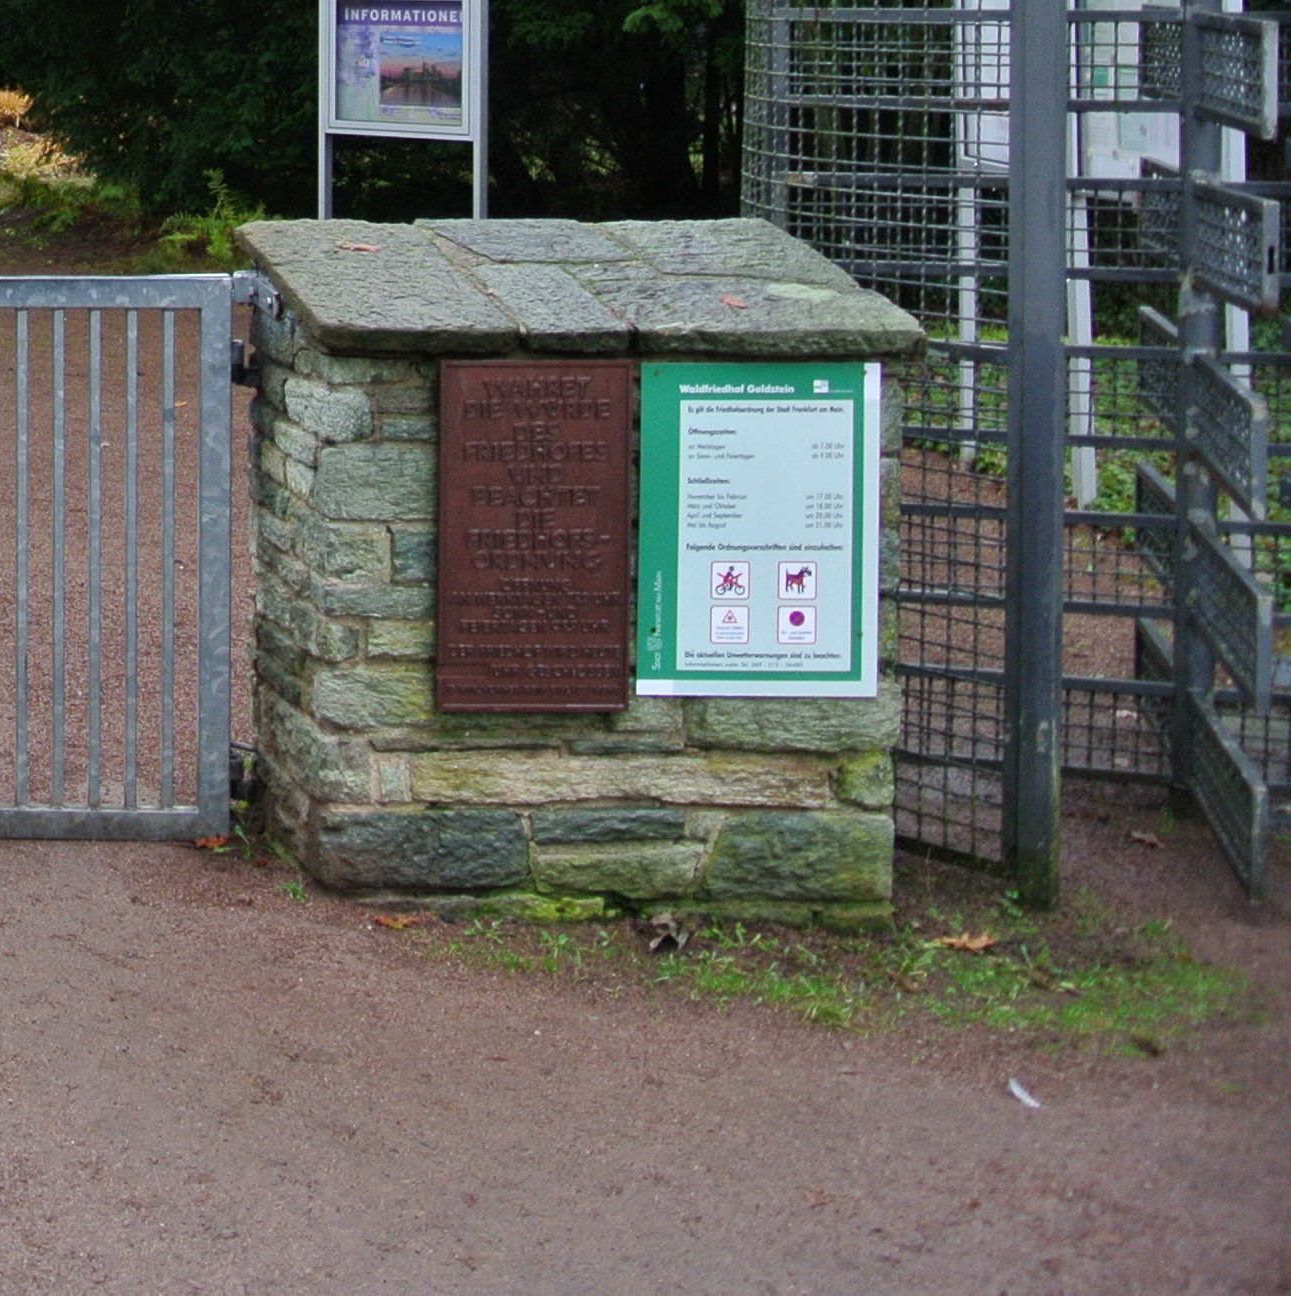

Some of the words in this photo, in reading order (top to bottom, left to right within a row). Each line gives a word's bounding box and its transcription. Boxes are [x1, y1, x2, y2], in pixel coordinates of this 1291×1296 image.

[679, 384, 744, 394] Waldfriedhof
[747, 384, 795, 394] Goldstein
[464, 399, 502, 420] DIE
[514, 421, 559, 440] DES
[464, 441, 608, 461] FRIEDHOFES
[517, 508, 556, 527] DIE
[686, 543, 716, 552] Folgende
[718, 543, 787, 552] Ordnungsvorschriften
[788, 543, 803, 551] sind
